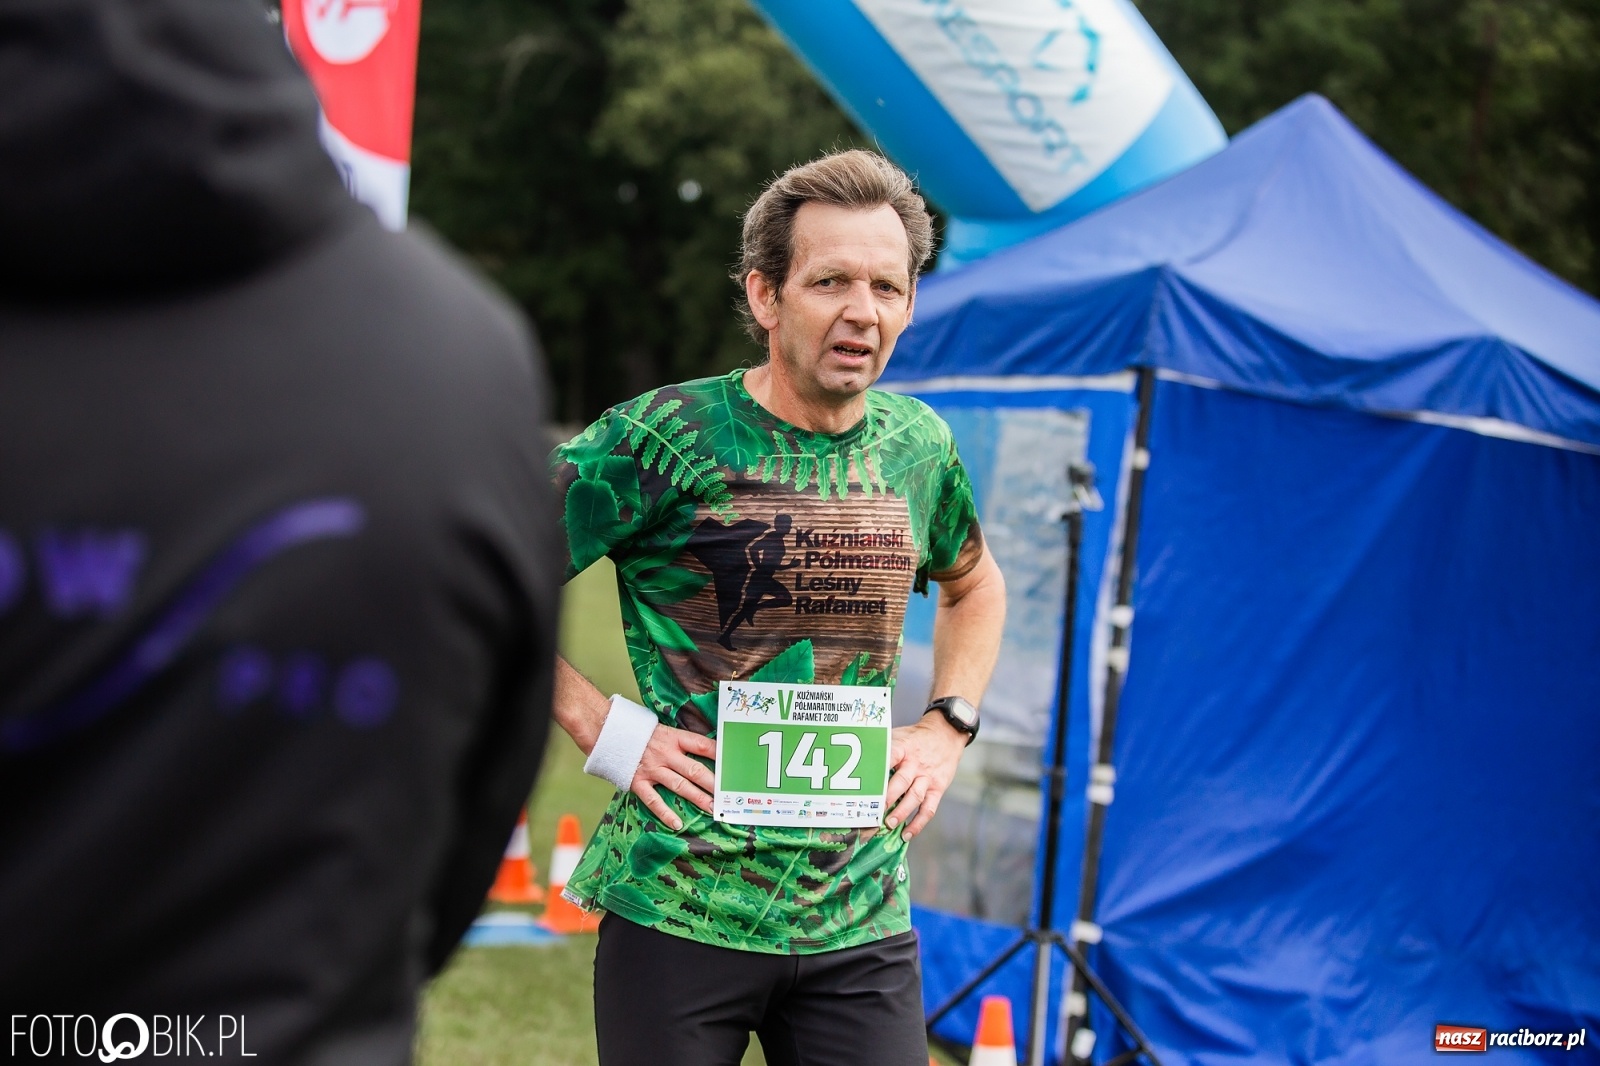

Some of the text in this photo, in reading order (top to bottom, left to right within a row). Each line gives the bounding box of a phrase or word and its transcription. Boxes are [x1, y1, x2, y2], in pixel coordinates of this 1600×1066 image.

[795, 528, 904, 547] Kuźniański
[805, 550, 911, 570] Półmaraton
[795, 572, 863, 595] Leśny
[795, 595, 888, 615] Rafamet
[777, 689, 795, 721] V
[796, 689, 834, 701] KUŹNIAŃSKI
[794, 701, 853, 713] PÓŁMARATON LEŚNY
[792, 713, 839, 723] RAFAMET 2020
[758, 730, 863, 790] 142
